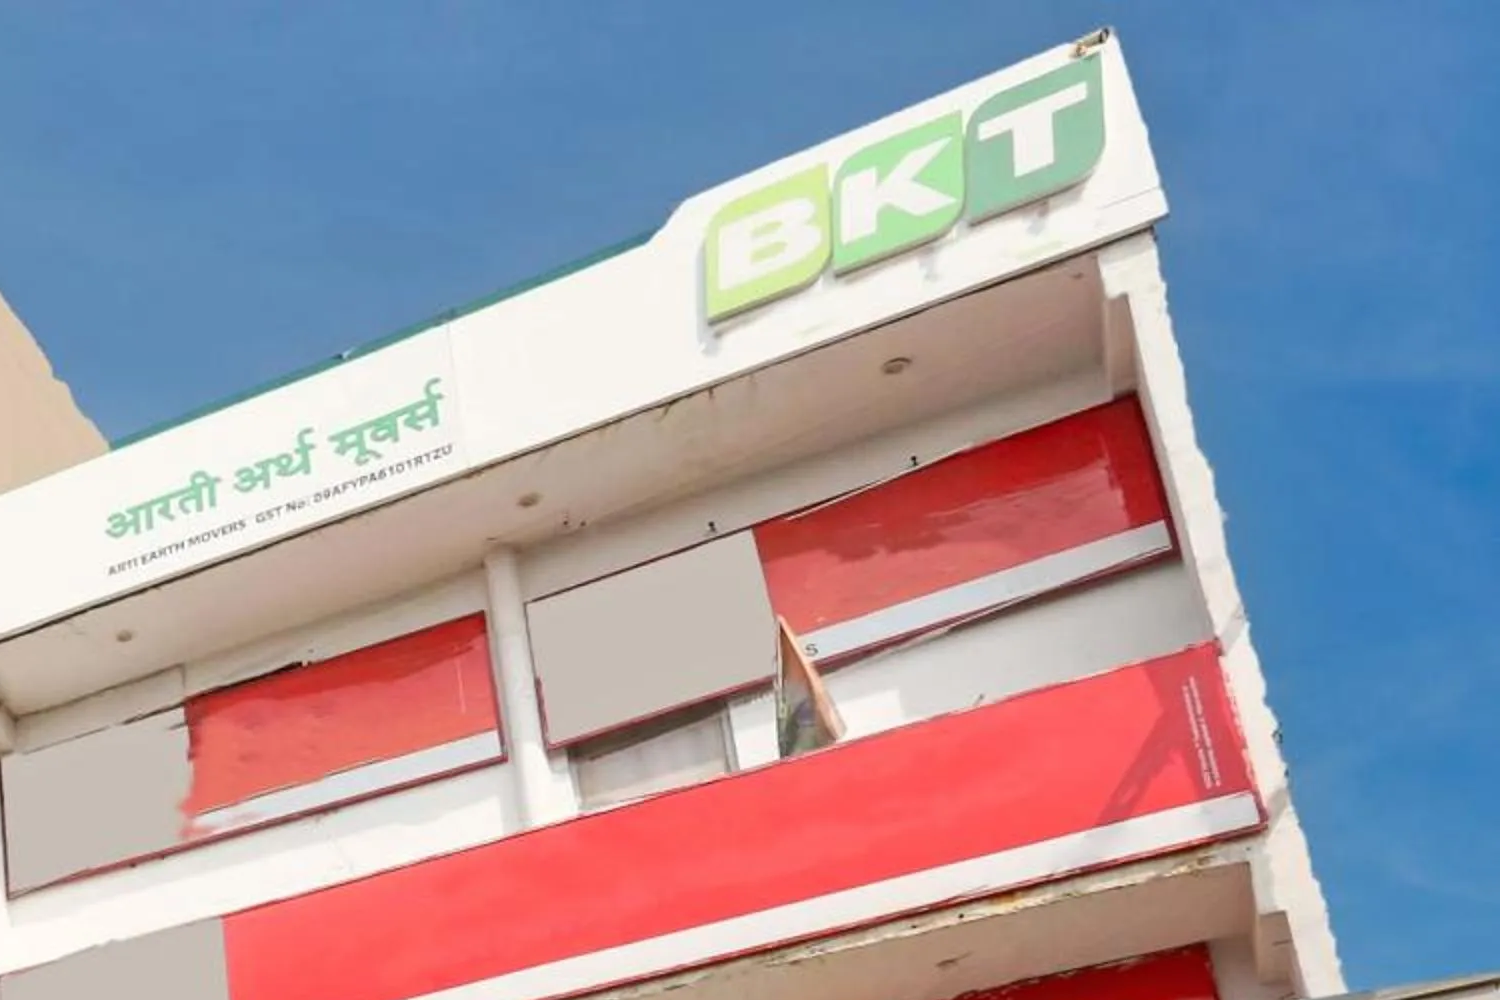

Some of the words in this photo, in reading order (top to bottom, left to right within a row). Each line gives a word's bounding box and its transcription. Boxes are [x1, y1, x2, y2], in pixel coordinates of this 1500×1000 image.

[714, 80, 1090, 293] BKT
[105, 469, 222, 539] आरती
[233, 427, 316, 492] अर्थ
[328, 377, 444, 466] मूवर्स
[108, 558, 139, 577] ARTI
[141, 540, 185, 565] EARTH
[187, 519, 246, 546] MOVERS
[255, 505, 283, 524] GST
